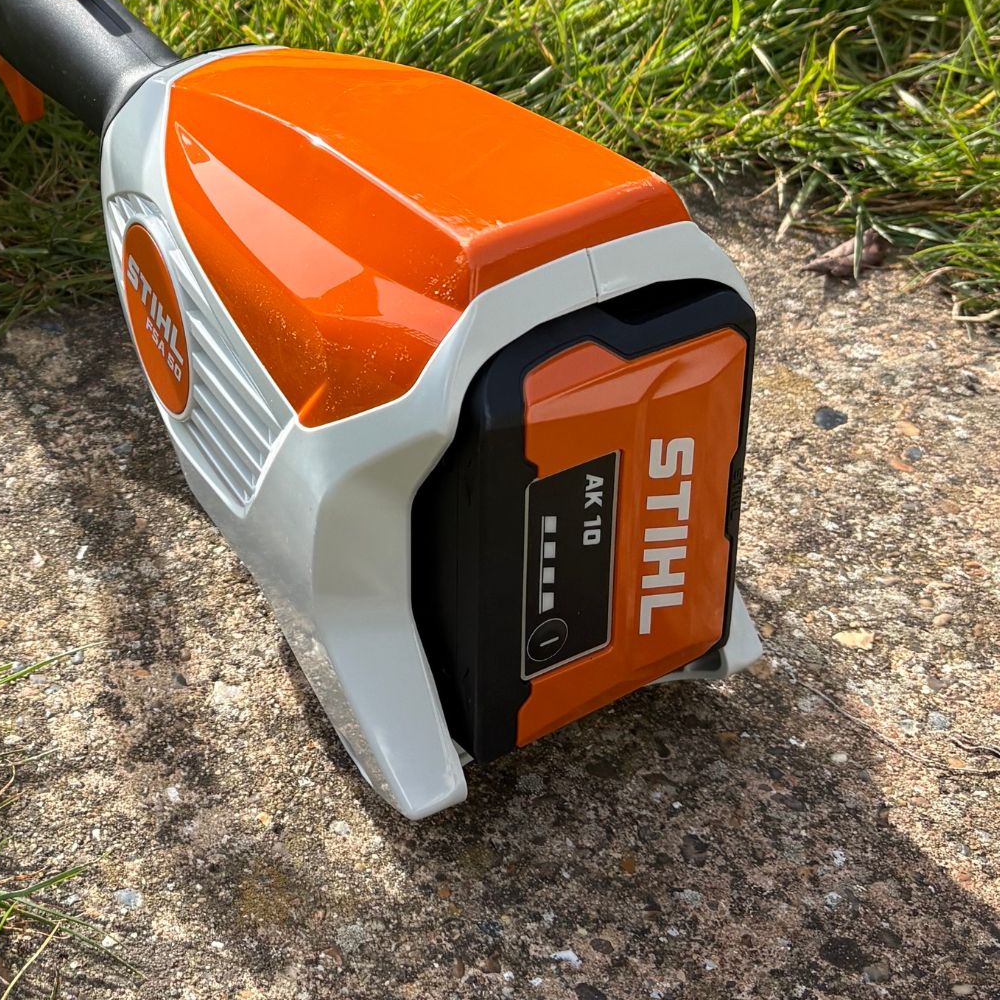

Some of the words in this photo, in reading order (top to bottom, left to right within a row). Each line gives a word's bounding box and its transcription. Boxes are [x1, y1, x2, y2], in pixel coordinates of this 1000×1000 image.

[126, 254, 184, 366] STIHL
[145, 316, 166, 357] FSA
[583, 473, 605, 509] AK
[582, 514, 602, 546] 10
[639, 437, 695, 635] STIHL
